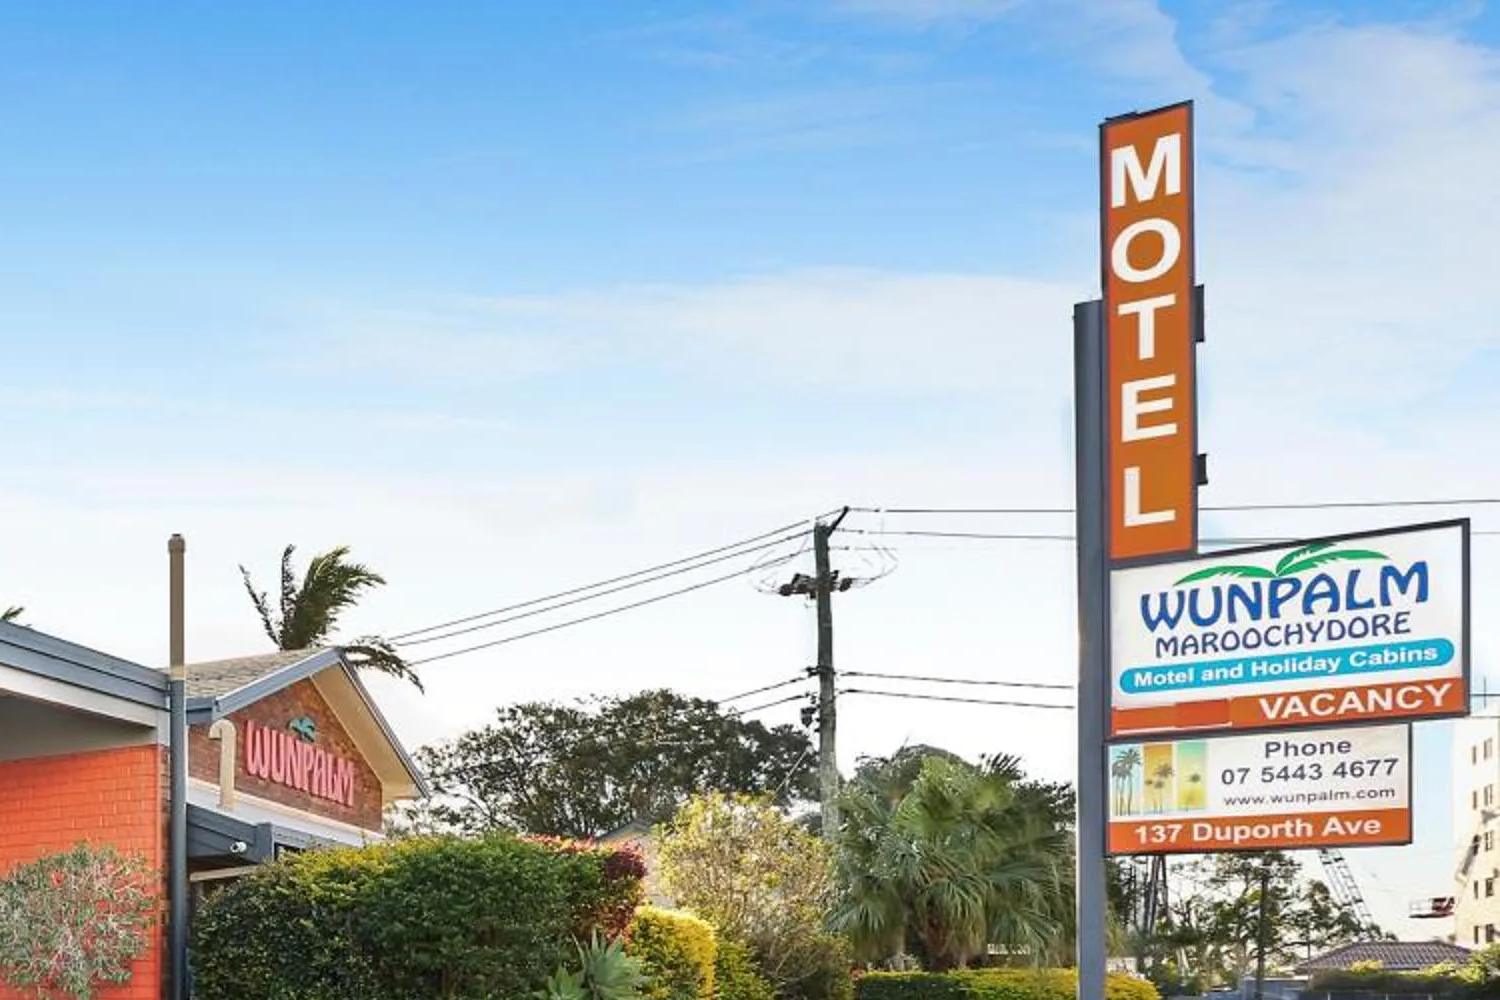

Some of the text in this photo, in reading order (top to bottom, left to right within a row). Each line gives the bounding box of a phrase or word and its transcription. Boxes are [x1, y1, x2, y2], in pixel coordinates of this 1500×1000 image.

[1110, 132, 1182, 528] MOTEL
[1140, 560, 1429, 633] WUNPALM
[1155, 611, 1411, 659] MAROOCHYDORE
[1134, 647, 1439, 688] Motel and Holiday Cabins
[1259, 683, 1452, 720] VACANCY
[245, 719, 355, 806] WUNPALM
[1265, 740, 1352, 759] Phone
[1221, 758, 1399, 785] 07 5443 4677
[1223, 787, 1395, 806] www.wunpalm.com
[1135, 816, 1381, 845] 137 Duporth Ave
